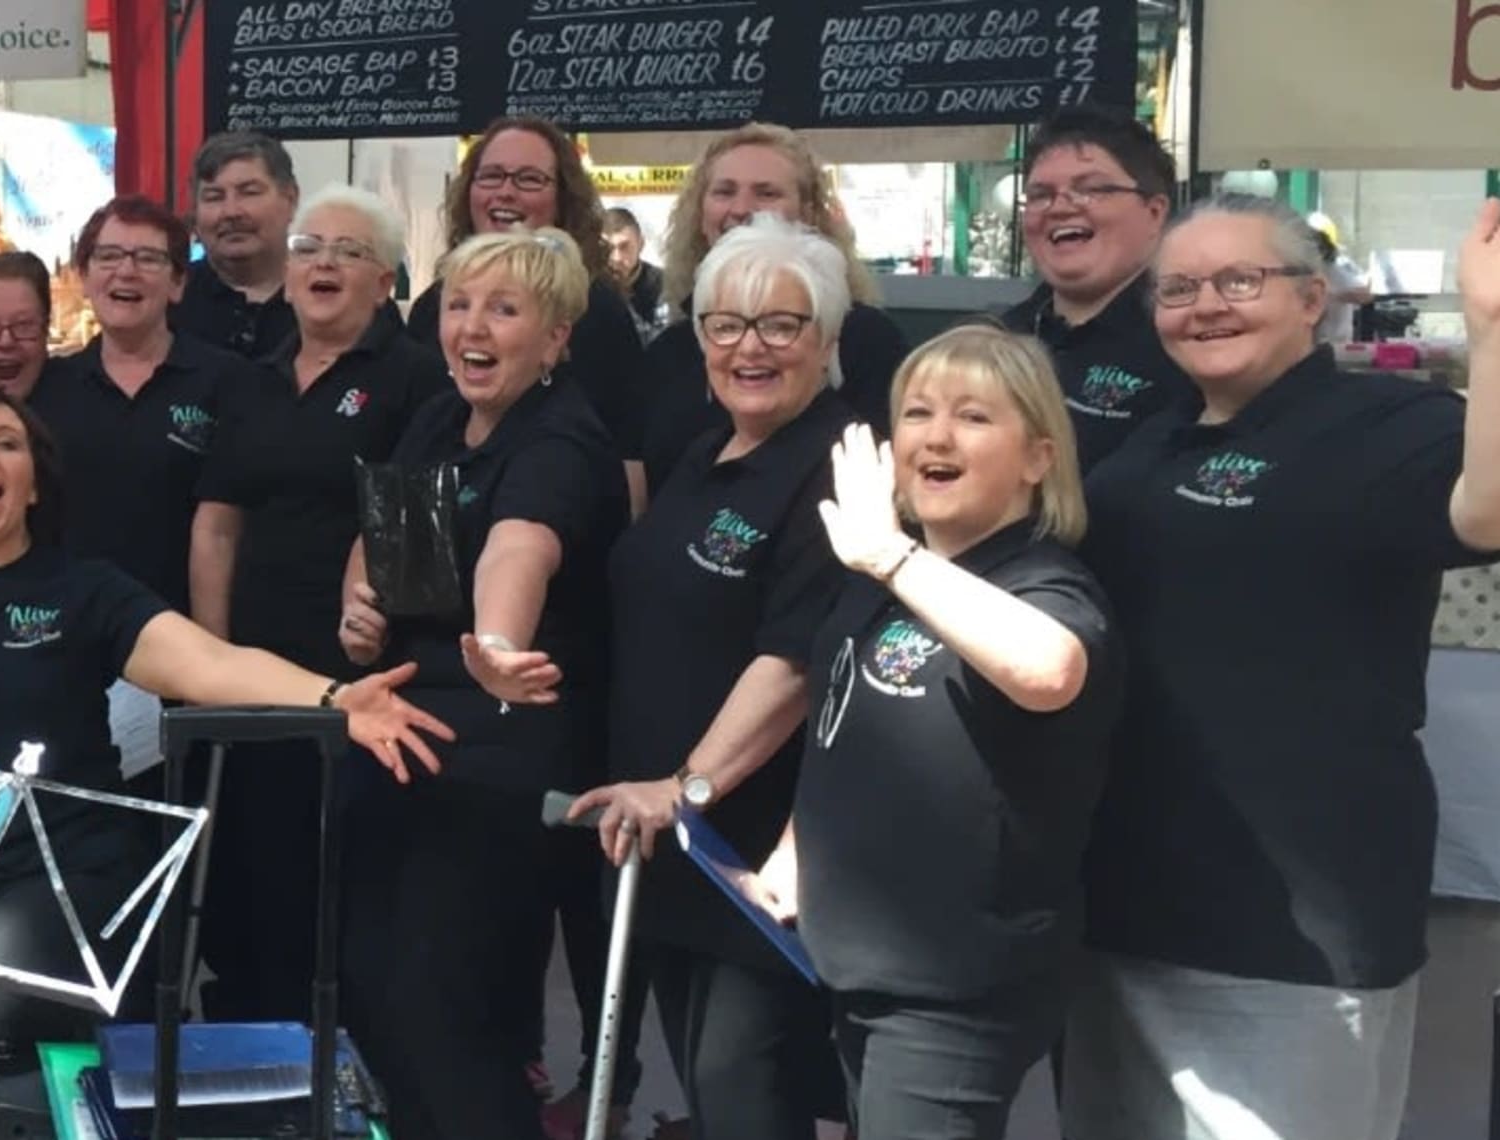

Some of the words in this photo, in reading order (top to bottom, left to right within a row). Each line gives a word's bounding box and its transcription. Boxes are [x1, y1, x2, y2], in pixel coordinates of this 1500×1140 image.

[234, 23, 296, 45] BAPS
[316, 18, 372, 37] SODA
[378, 10, 454, 33] BREAD
[237, 4, 279, 26] ALL
[285, 1, 332, 22] DAY
[821, 16, 901, 44] PULLED
[904, 11, 977, 40] PORK
[980, 9, 1039, 37] BAP
[556, 23, 625, 54] STEAK
[628, 20, 723, 51] BURGER
[821, 41, 945, 69] BREAKFAST
[944, 36, 1049, 64] BURRITO
[243, 53, 359, 78] SAUSAGE
[364, 50, 418, 72] BAP
[560, 56, 633, 89] STEAK
[633, 53, 721, 87] BURGER
[820, 67, 903, 91] CHIPS
[245, 77, 333, 99] BACON
[340, 73, 396, 96] BAP
[821, 89, 929, 118] HOT/COLD
[937, 85, 1043, 113] DRINKS
